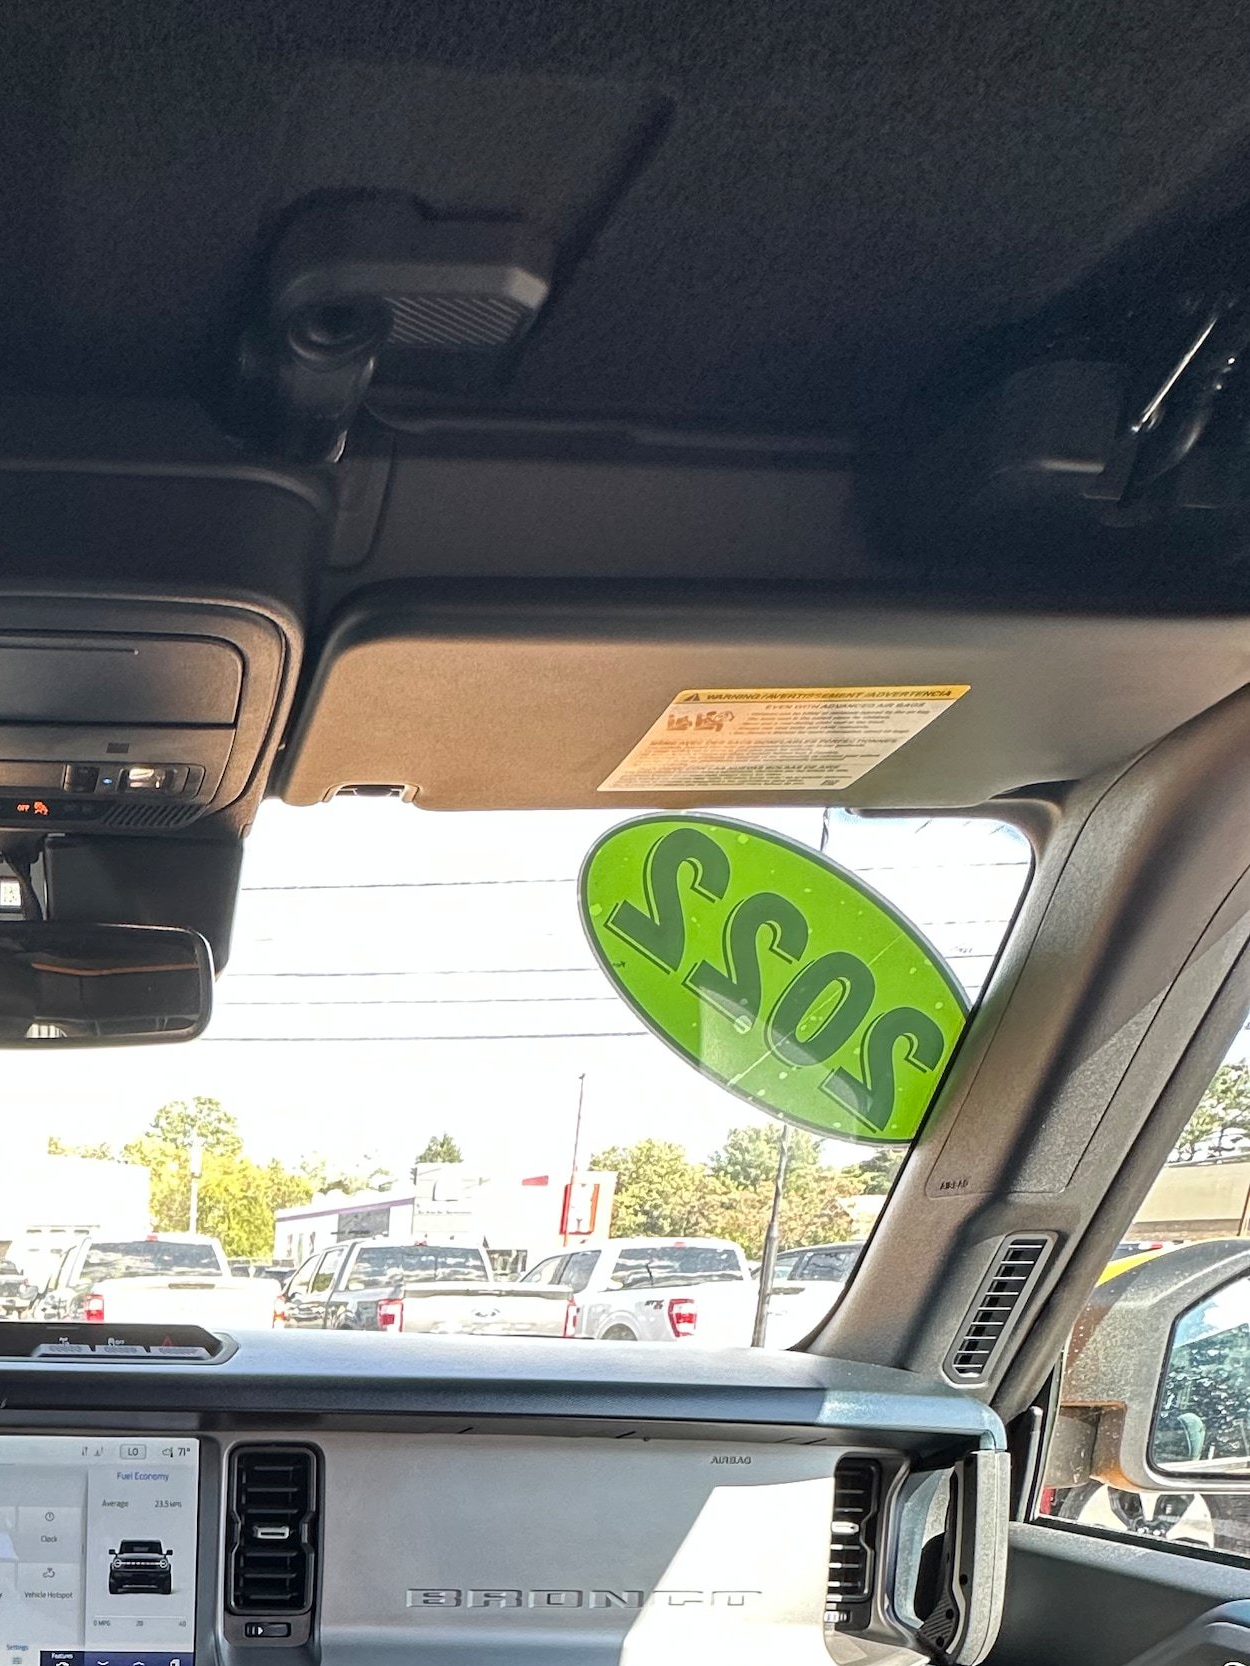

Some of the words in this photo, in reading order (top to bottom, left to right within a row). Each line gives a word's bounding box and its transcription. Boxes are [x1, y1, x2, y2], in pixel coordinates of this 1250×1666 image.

[16, 804, 30, 812] OFF
[116, 1472, 133, 1480] Fuel
[134, 1472, 169, 1481] Economy
[102, 1500, 129, 1508] Average
[154, 1500, 169, 1508] 23.5
[40, 1535, 57, 1543] Clock
[24, 1591, 46, 1599] Vehicle
[47, 1591, 73, 1600] Hotspot
[6, 1643, 29, 1651] Settings
[51, 1652, 74, 1660] Features
